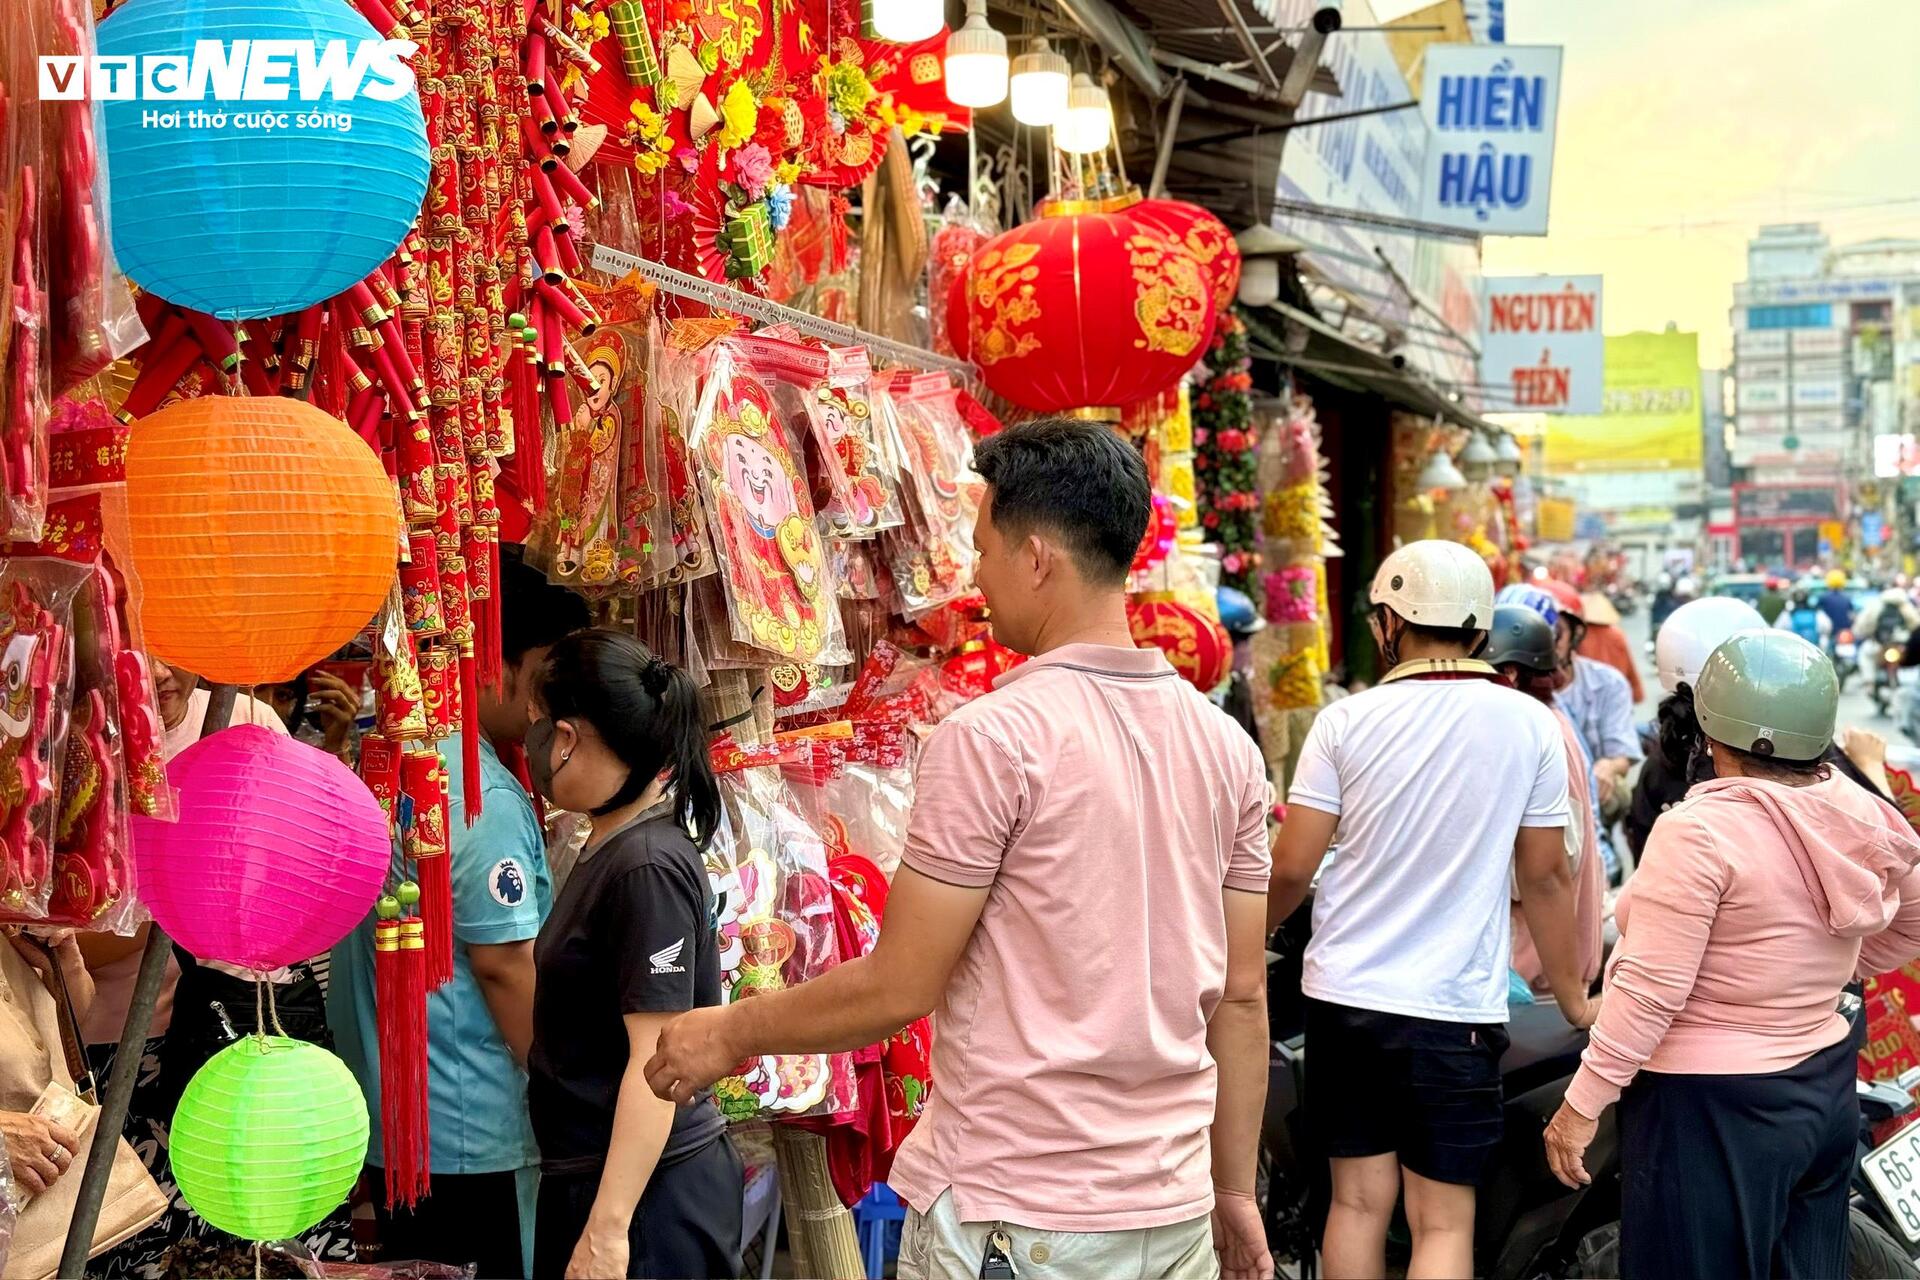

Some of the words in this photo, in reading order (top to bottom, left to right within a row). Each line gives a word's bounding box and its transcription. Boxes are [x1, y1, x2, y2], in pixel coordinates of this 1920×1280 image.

[1438, 141, 1533, 220] HẬU
[1489, 282, 1596, 334] NGUYÊN
[650, 966, 686, 974] HONDA
